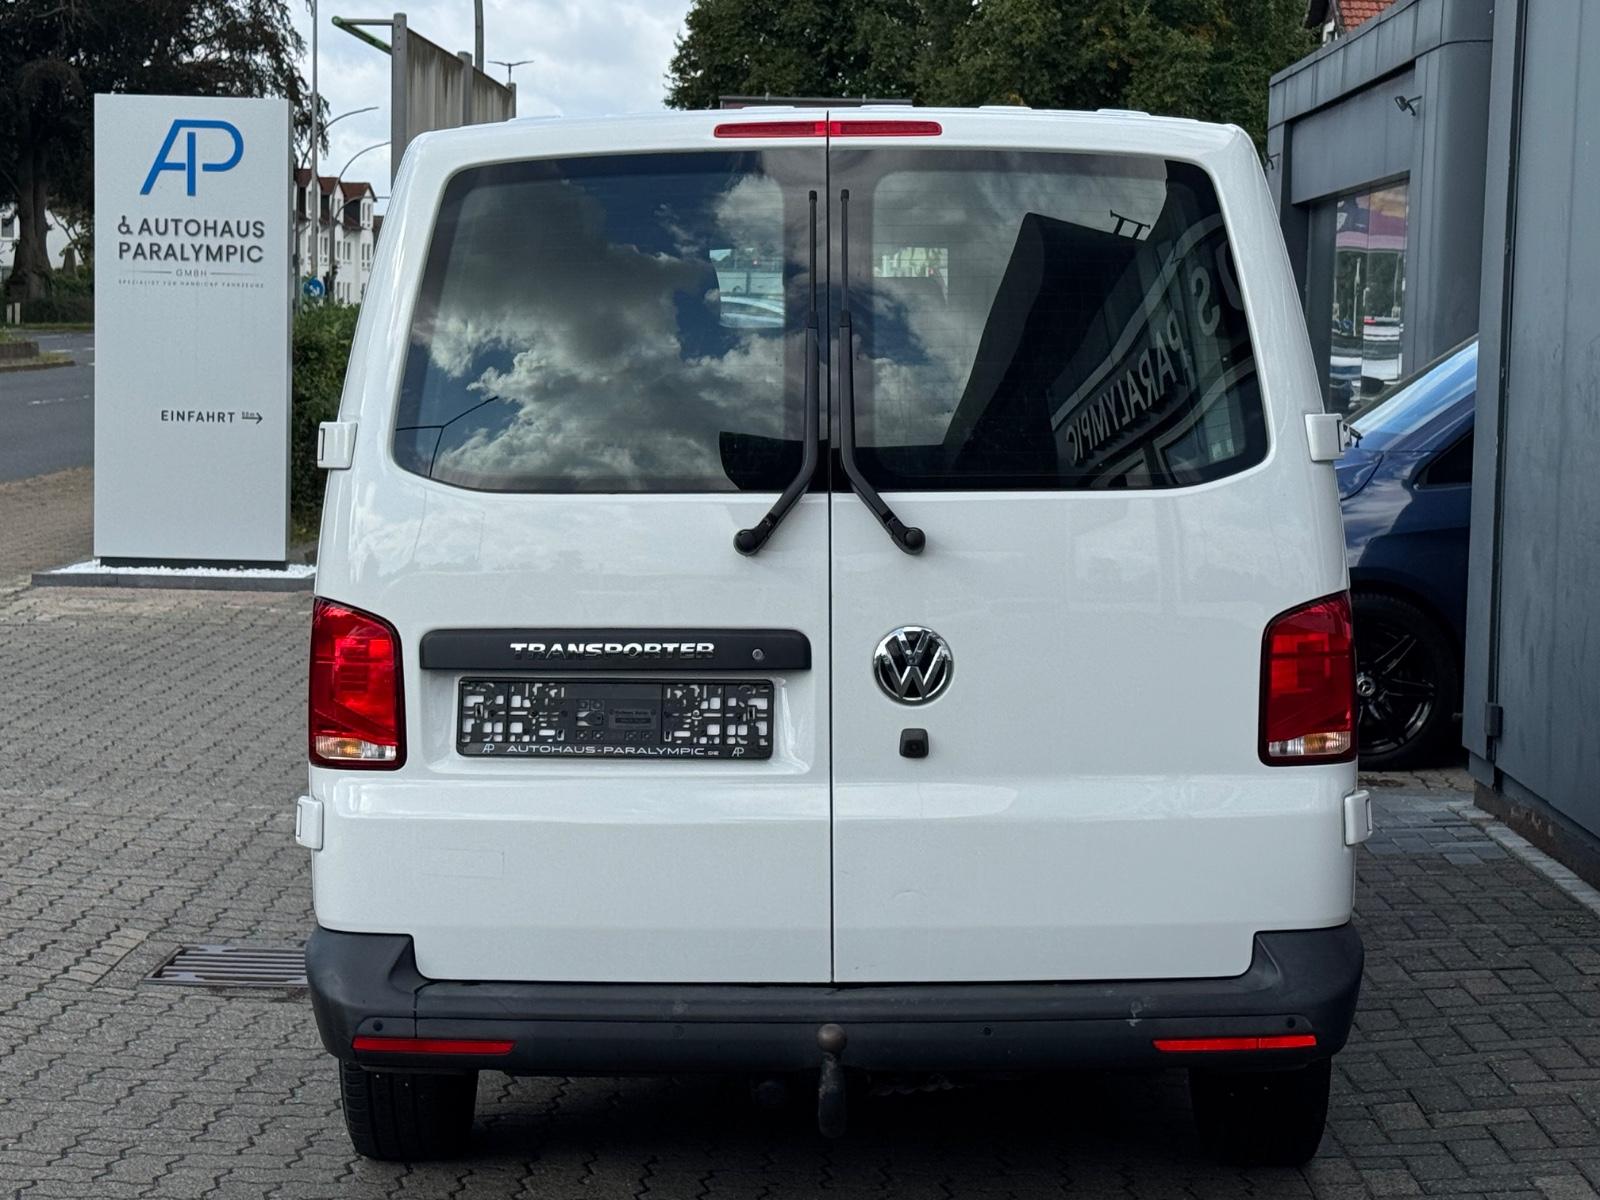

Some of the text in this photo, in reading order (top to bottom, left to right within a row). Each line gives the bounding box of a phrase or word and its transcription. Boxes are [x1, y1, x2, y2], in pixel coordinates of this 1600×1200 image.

[140, 119, 244, 197] AP
[138, 218, 265, 239] AUTOHAUS
[118, 242, 264, 263] PARALYMPIC
[161, 410, 236, 423] EINFAHRT
[510, 643, 715, 659] TRANSPORTER
